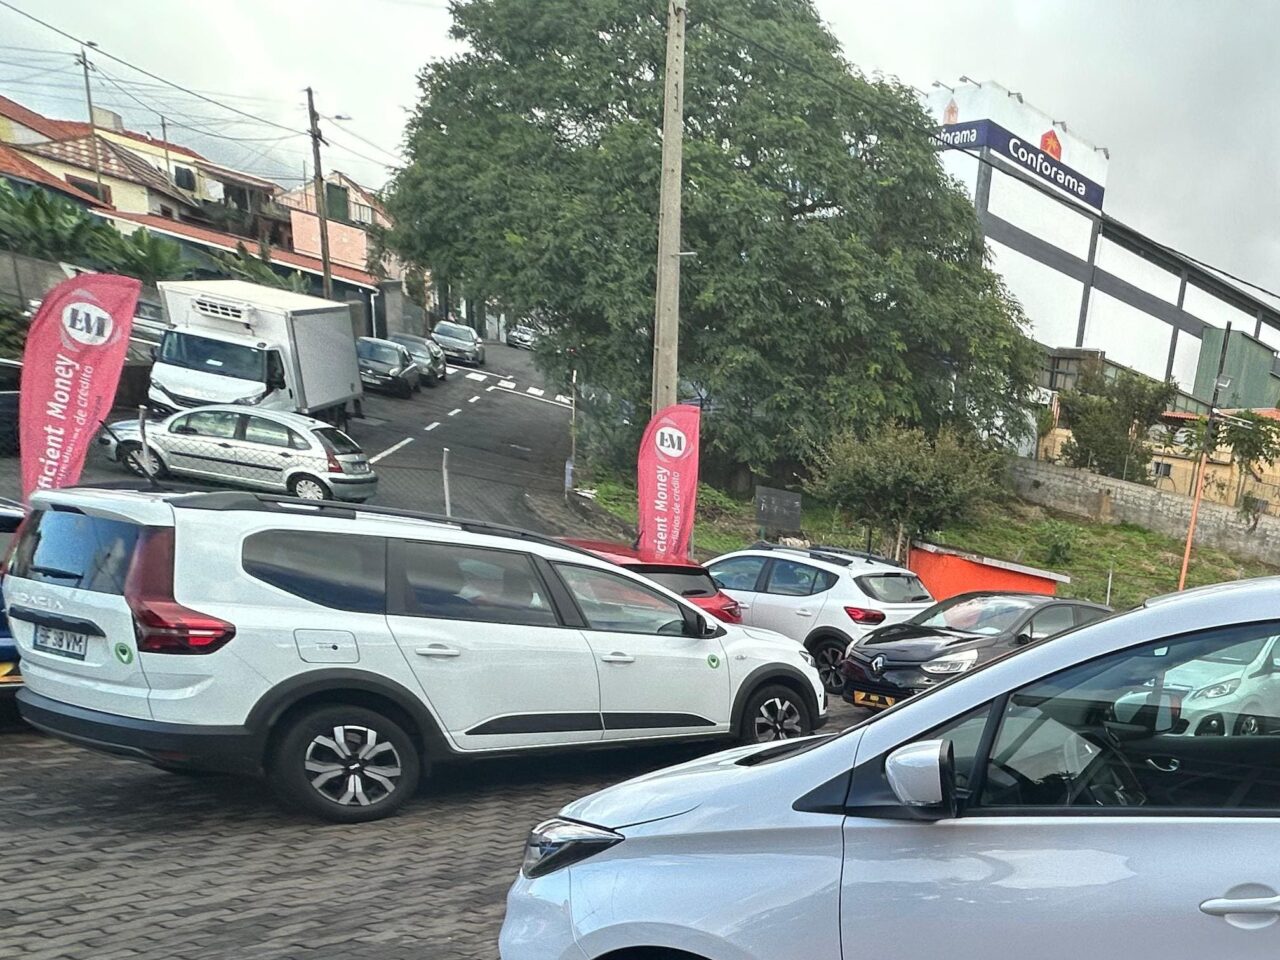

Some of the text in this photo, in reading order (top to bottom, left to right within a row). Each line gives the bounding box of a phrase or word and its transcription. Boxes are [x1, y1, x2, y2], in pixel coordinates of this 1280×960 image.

[1008, 137, 1086, 196] Conforama
[68, 308, 108, 338] EM
[46, 354, 79, 420] Money
[77, 405, 89, 426] de
[659, 431, 683, 451] EM
[653, 465, 670, 555] cient Money
